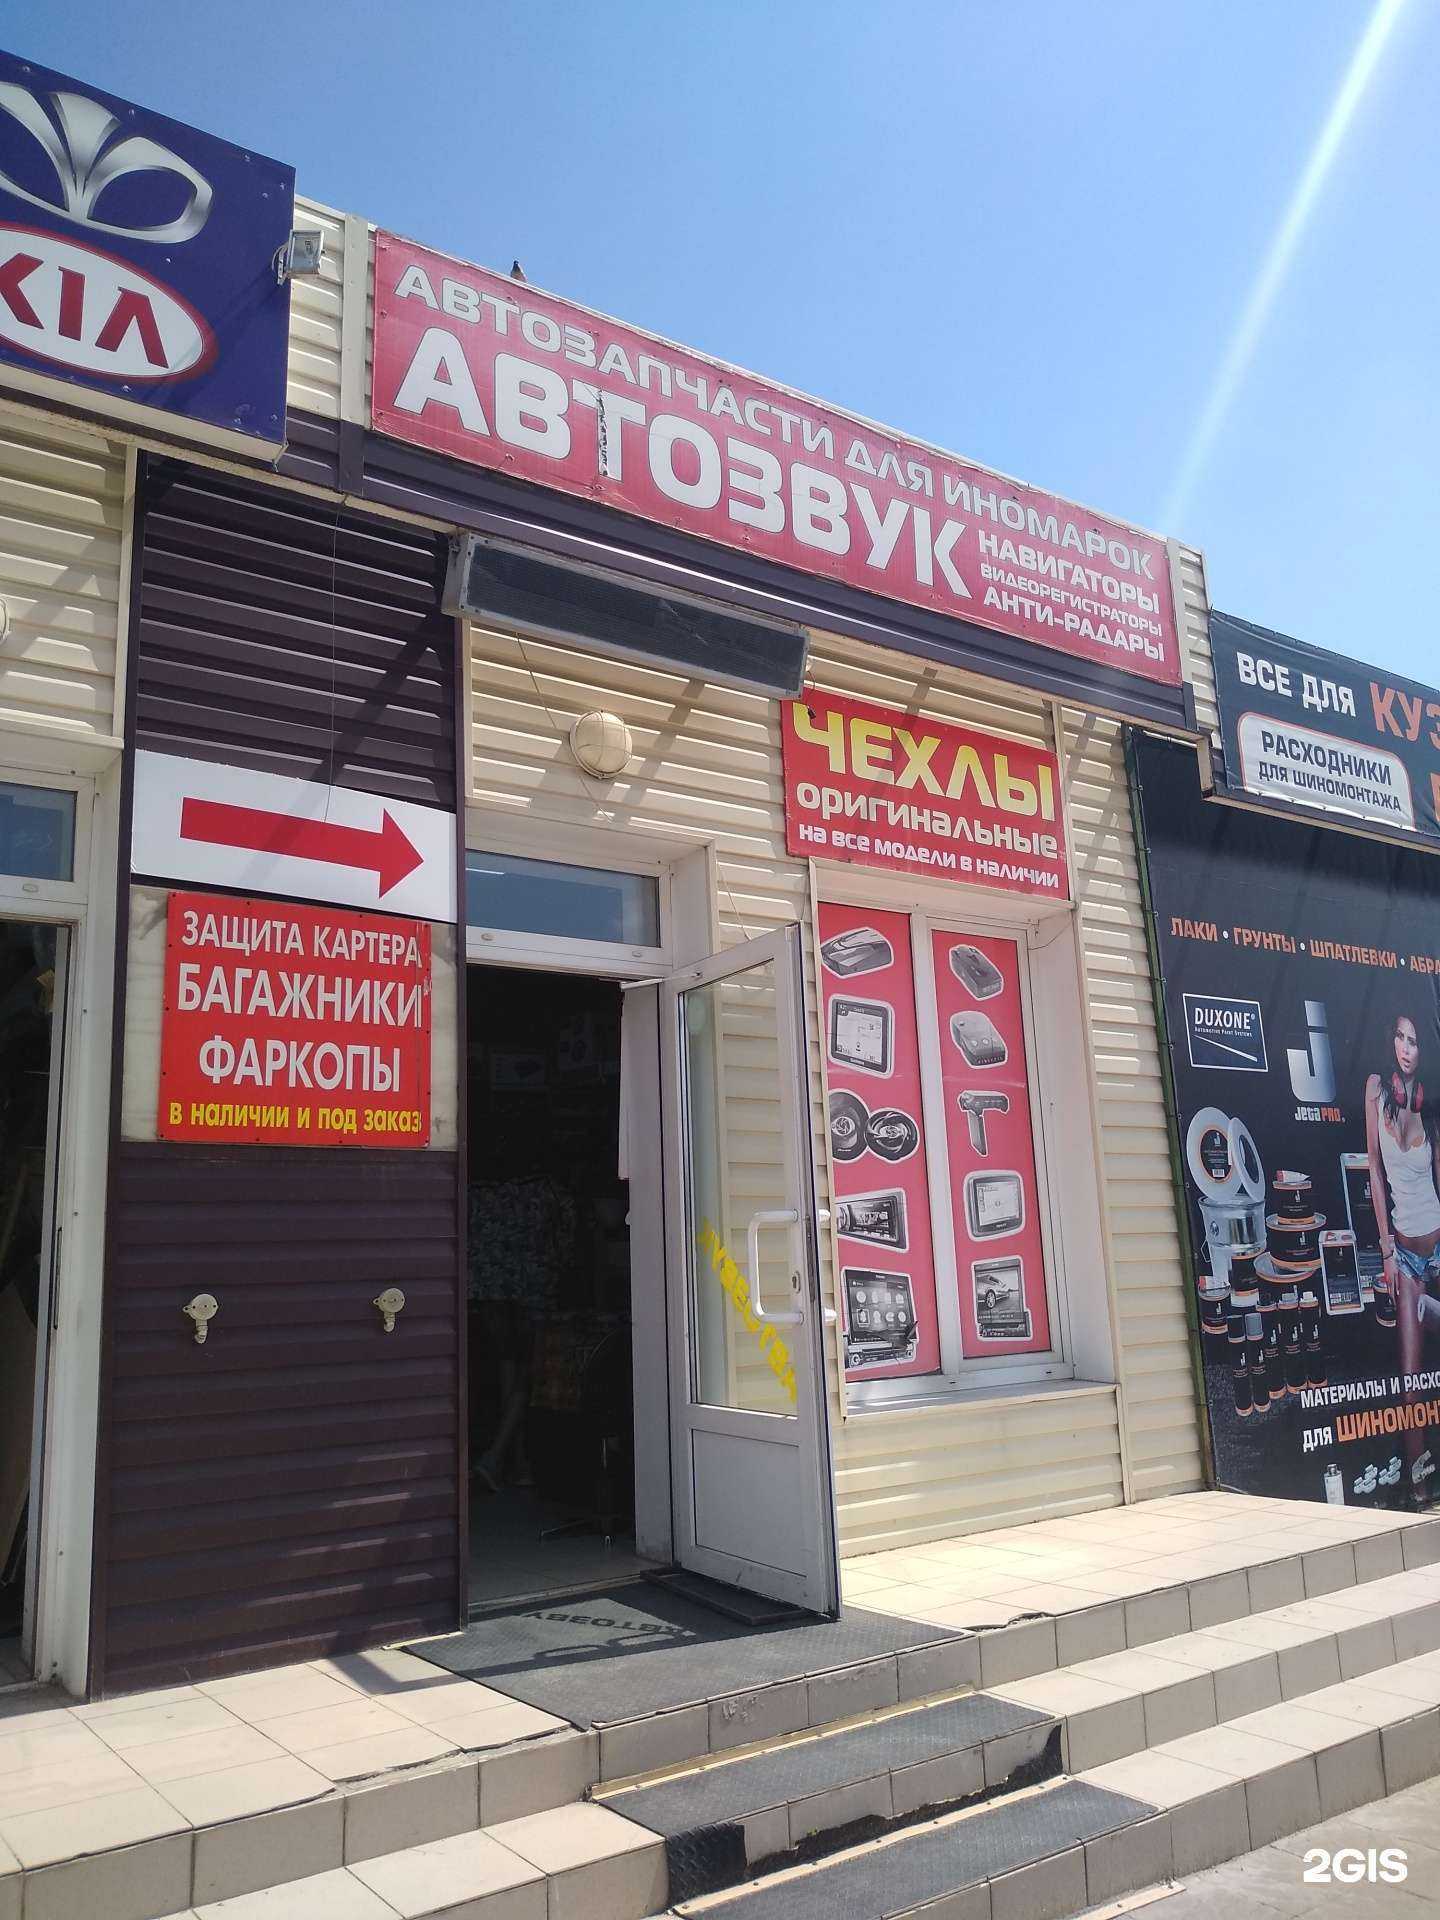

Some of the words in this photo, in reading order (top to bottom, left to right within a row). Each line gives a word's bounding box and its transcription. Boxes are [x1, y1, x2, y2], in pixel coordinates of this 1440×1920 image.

[0, 252, 170, 369] KIA
[393, 264, 836, 460] АВТОЗАПЧАСТИ
[844, 439, 934, 498] ДЛЯ
[942, 474, 1155, 581] ИНОМАРОК
[392, 326, 973, 599] АВТОЗВУК
[978, 529, 1160, 615] НАВИГАТОРЫ
[980, 562, 1163, 637] ВИДЕОРЕГИСТРАТОРЫ
[983, 585, 1165, 662] АНТИ-РАДАРЫ
[1236, 651, 1293, 698] ВСЕ
[1302, 672, 1357, 718] ДЛЯ
[792, 701, 1056, 822] ЧЕХЛЫ
[1258, 761, 1288, 783] ДЛЯ
[1293, 769, 1402, 812] ШИНОМОНТАЖА
[1261, 730, 1392, 786] РАСХОДНИКИ
[796, 782, 1058, 859] оригинальные
[799, 823, 826, 844] на
[832, 827, 870, 852] все
[874, 838, 957, 870] модели
[977, 859, 1059, 889] наличии
[181, 910, 304, 957] ЗАЩИТА
[313, 924, 423, 968] КАРТЕРА
[1170, 917, 1218, 942] ЛАКИ
[1233, 927, 1296, 954] ГРУНТЫ
[1309, 939, 1398, 969] ШПАТЛЕВКИ
[177, 962, 423, 1029] БАГАЖНИКИ
[199, 1035, 400, 1093] ФАРКОПЫ
[191, 1103, 289, 1128] наличии
[297, 1107, 310, 1129] и
[318, 1107, 357, 1135] под
[363, 1108, 422, 1132] заказ
[1300, 1378, 1387, 1409] МАТЕРИАЛЫ
[1390, 1377, 1400, 1395] И
[1302, 1426, 1333, 1453] ДЛЯ
[1336, 1400, 1440, 1442] ШИНОМОН
